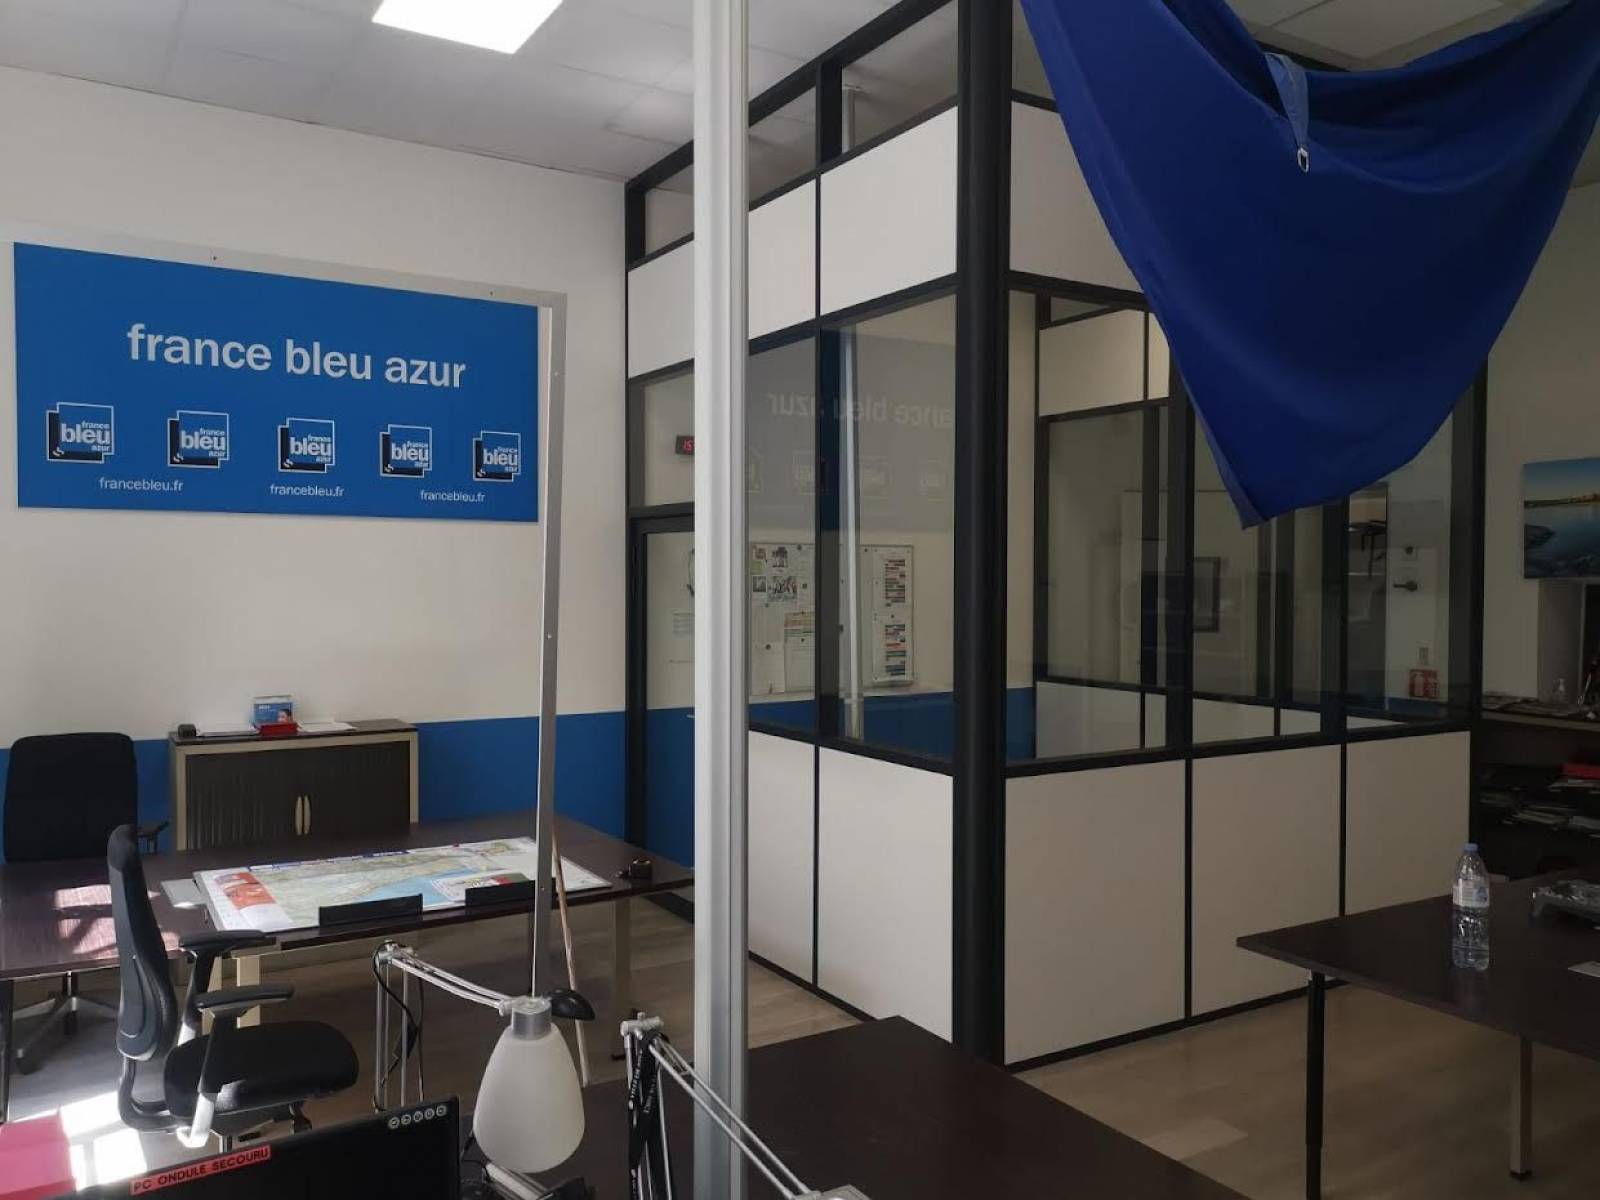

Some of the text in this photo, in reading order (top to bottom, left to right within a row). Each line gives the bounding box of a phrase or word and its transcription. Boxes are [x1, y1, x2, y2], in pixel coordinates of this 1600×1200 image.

[127, 323, 466, 388] france bleu azur
[61, 423, 110, 445] bleu
[181, 430, 226, 450] bleu
[290, 436, 332, 457] bleu
[391, 442, 429, 461] bleu
[483, 447, 518, 466] bleu
[99, 477, 184, 492] francebleu.fr
[270, 484, 345, 497] francebleu.fr
[420, 489, 486, 503] francebleu.fr
[133, 1147, 270, 1193] PC ONDULE SECOURU
